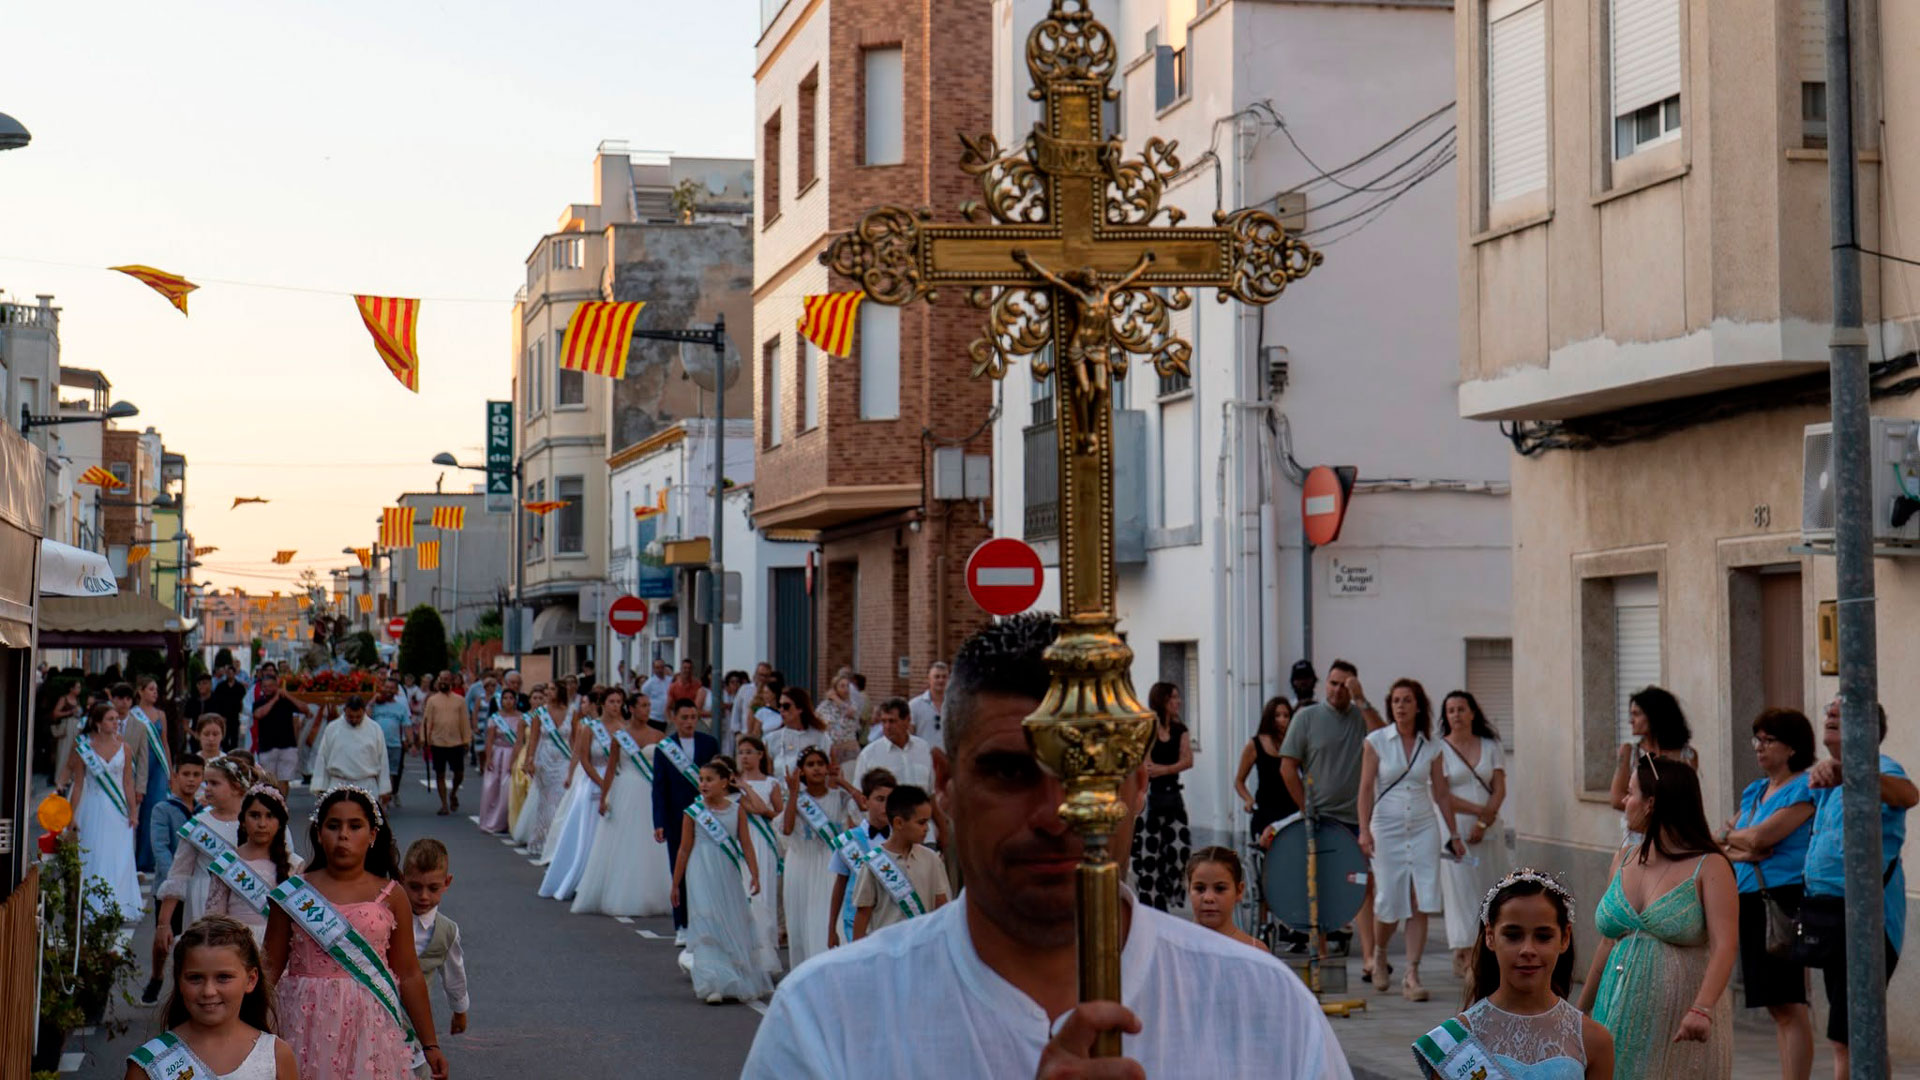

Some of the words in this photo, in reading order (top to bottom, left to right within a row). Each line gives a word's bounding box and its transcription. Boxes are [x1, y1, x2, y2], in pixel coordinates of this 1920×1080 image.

[491, 403, 510, 448] FORN
[489, 453, 511, 463] de
[1754, 504, 1771, 528] 83
[165, 1056, 185, 1076] 2025
[1457, 1056, 1476, 1077] 2025
